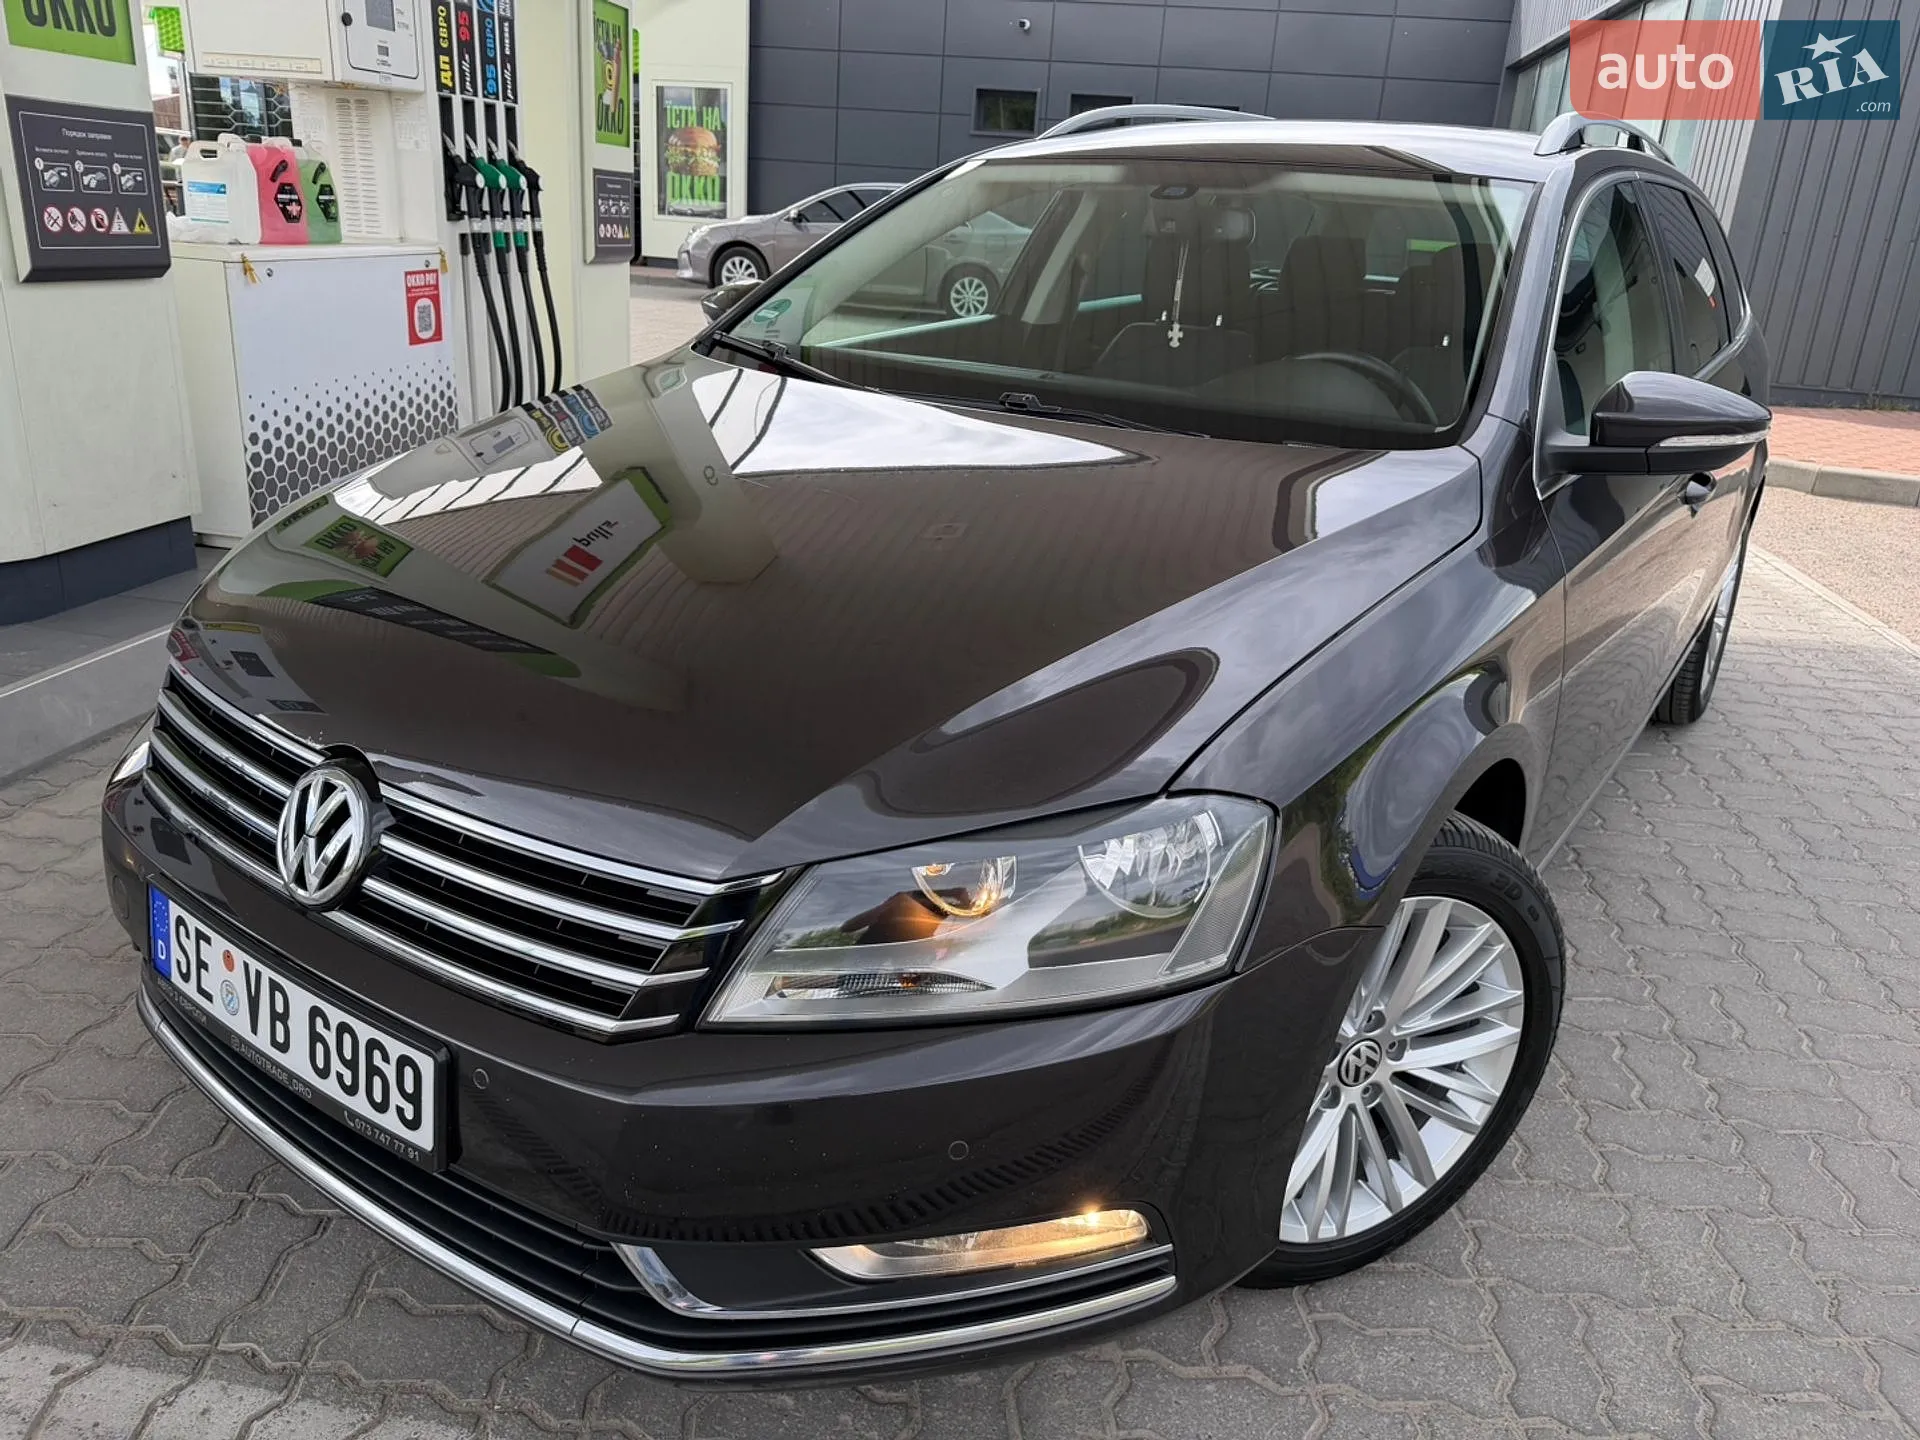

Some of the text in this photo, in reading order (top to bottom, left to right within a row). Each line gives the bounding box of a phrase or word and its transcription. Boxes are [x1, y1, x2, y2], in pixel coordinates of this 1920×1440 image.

[457, 10, 471, 43] 95
[439, 54, 454, 88] ДП
[485, 63, 498, 95] 95
[702, 105, 721, 131] НА
[157, 940, 167, 961] D
[174, 914, 423, 1132] SE VB 6969
[373, 1128, 391, 1146] 747
[393, 1139, 405, 1154] 77
